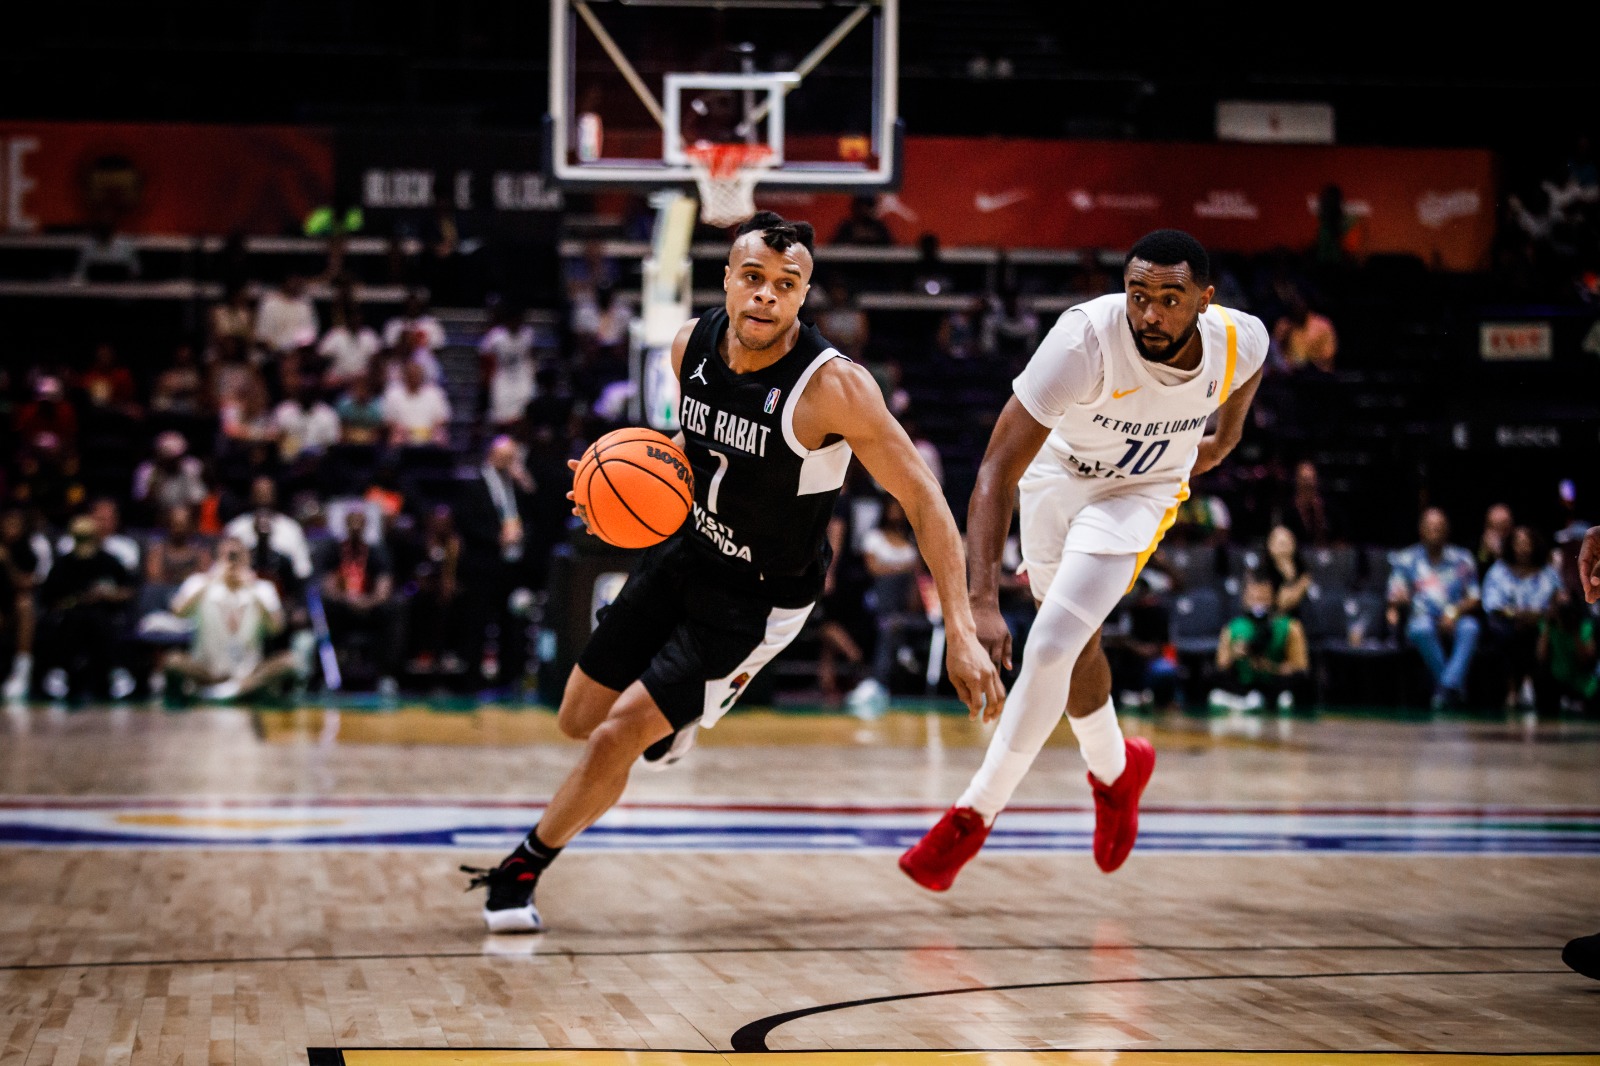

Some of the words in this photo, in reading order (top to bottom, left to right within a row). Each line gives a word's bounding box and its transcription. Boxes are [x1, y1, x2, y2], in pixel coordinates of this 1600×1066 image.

[681, 395, 711, 436] FUS
[713, 410, 772, 458] RABAT
[1093, 413, 1140, 436] PETRO
[1143, 421, 1164, 437] DE
[1115, 438, 1171, 475] 10
[707, 449, 729, 514] 7
[693, 500, 734, 539] VISIT
